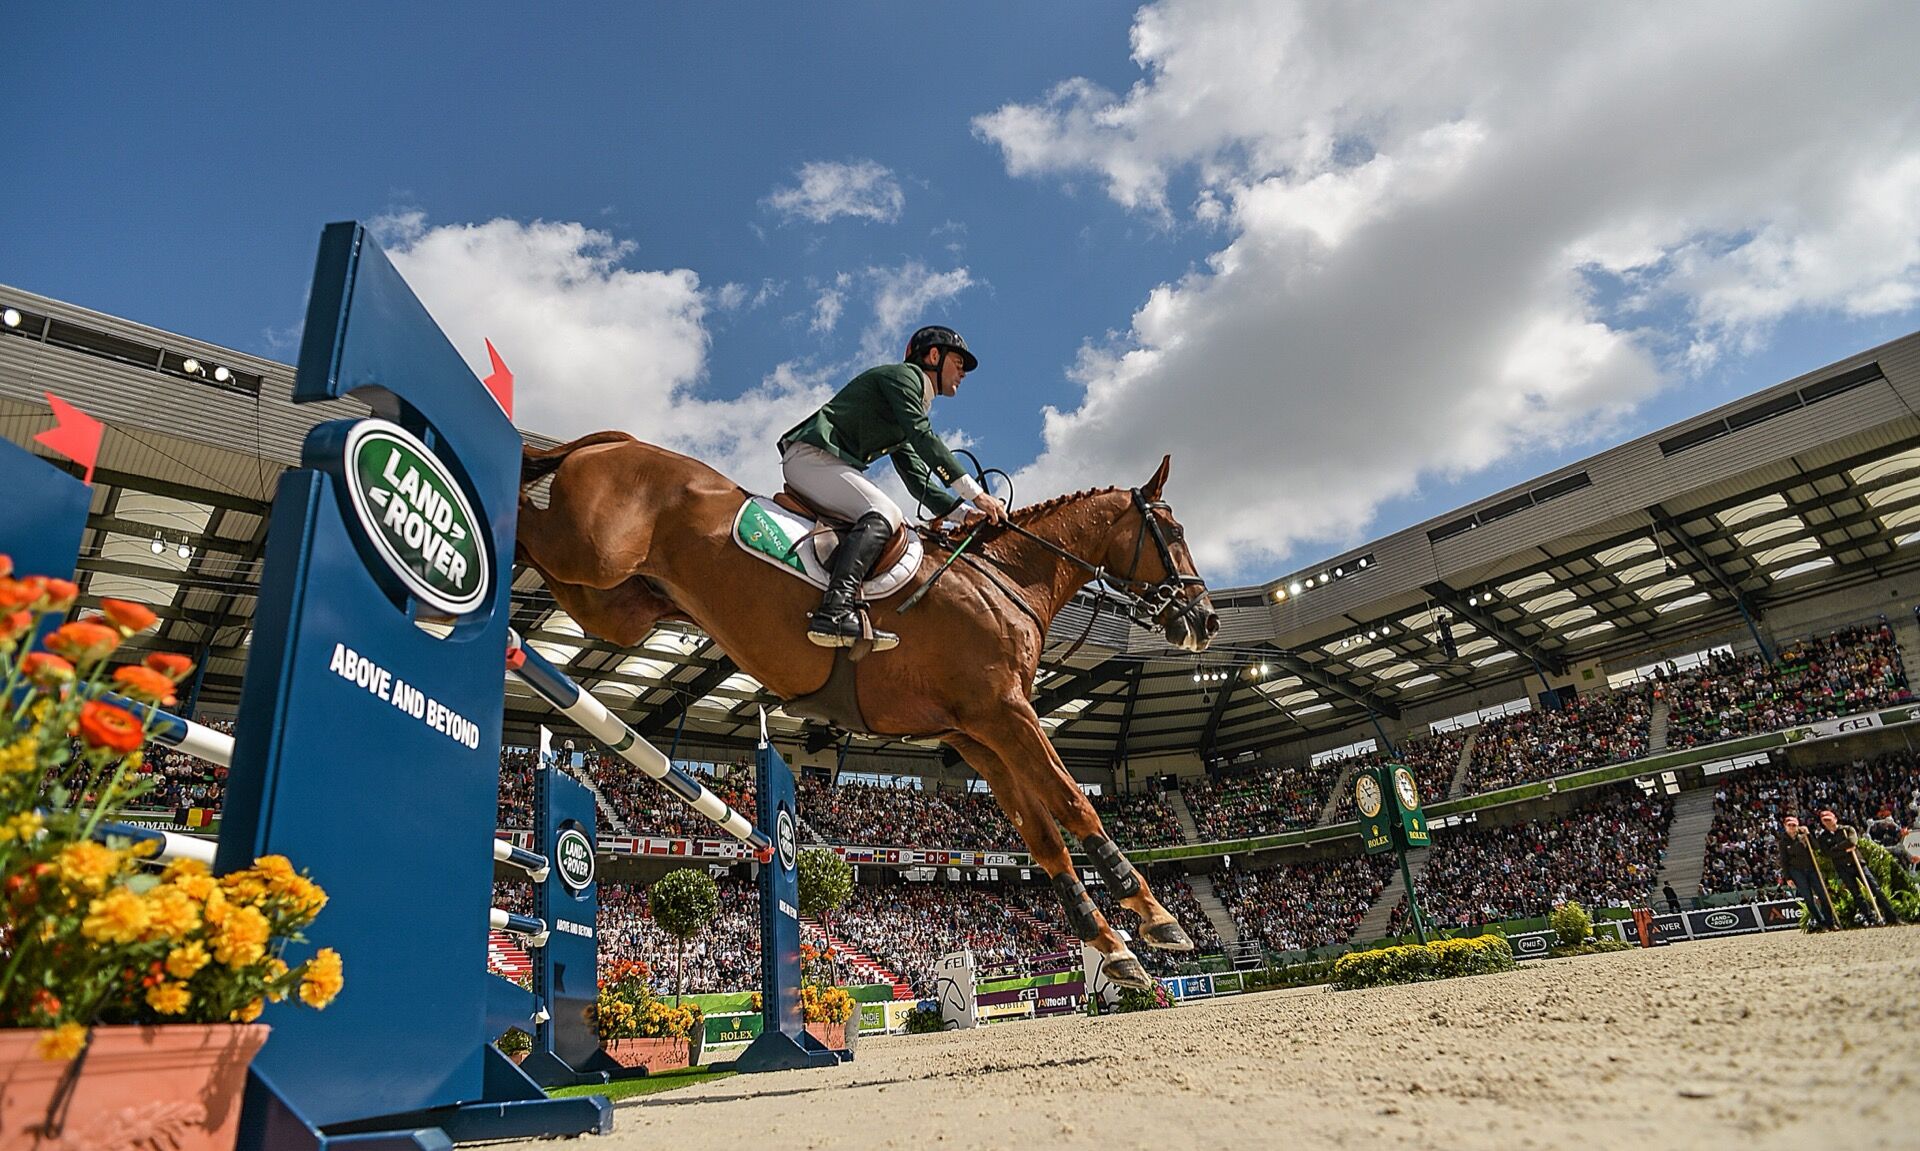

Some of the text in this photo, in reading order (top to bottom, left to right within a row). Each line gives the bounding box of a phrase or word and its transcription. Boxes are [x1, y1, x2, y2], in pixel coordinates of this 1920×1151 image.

[382, 448, 454, 534] LAND
[383, 492, 468, 590] ROVER
[329, 642, 480, 751] ABOVE AND BEYOND
[1367, 835, 1389, 848] ROLEX
[1408, 831, 1428, 840] ROLEX
[565, 839, 584, 860] LAND
[566, 857, 589, 877] ROVER
[1768, 907, 1803, 921] Allte
[1714, 918, 1733, 926] ROVER
[1522, 940, 1536, 949] PMU
[943, 956, 965, 970] FEI
[1017, 987, 1039, 1001] FEI
[720, 1030, 753, 1041] ROLEX
